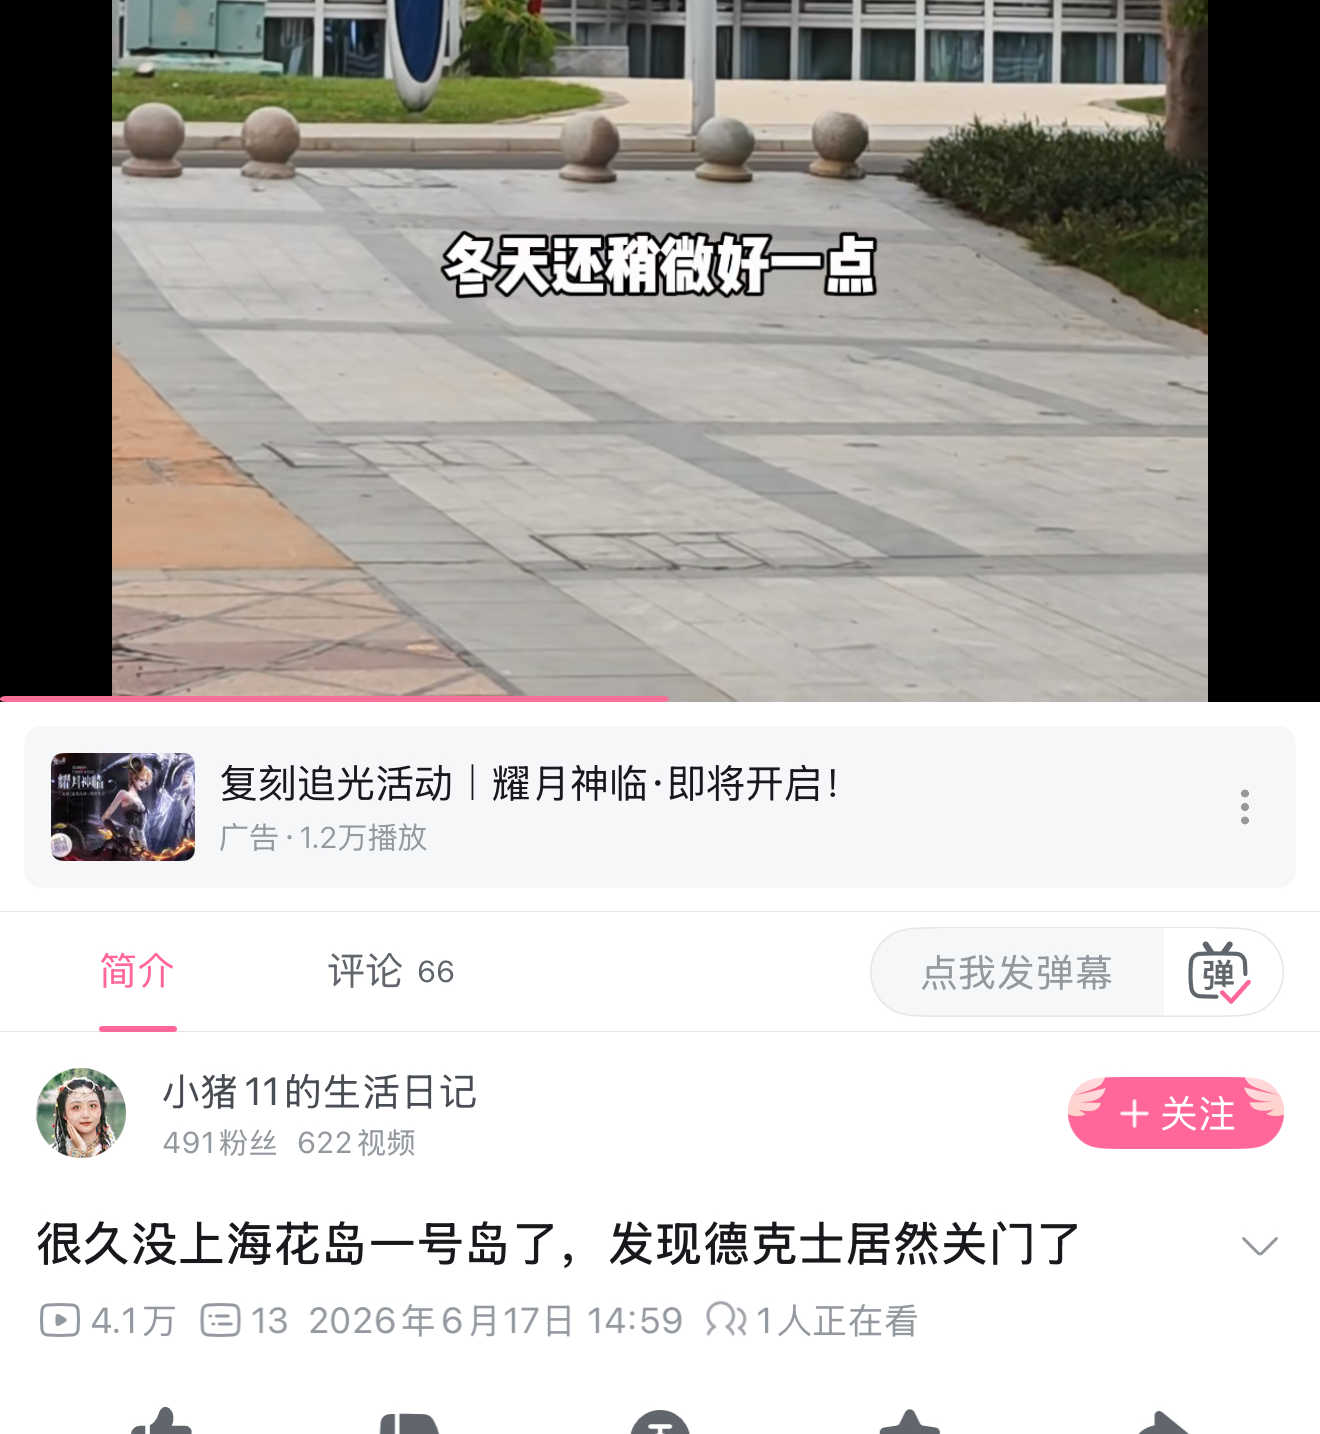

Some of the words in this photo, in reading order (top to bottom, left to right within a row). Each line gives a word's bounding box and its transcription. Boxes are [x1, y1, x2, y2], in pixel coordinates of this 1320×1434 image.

[101, 953, 174, 989] 简介
[328, 953, 402, 989] 评论
[419, 960, 453, 983] 66
[922, 955, 1111, 991] 点我发弹幕
[1203, 959, 1234, 990] 弹
[163, 1074, 476, 1109] 小猪11的生活日记
[1162, 1096, 1235, 1132] 关注
[164, 1129, 276, 1157] 491粉丝
[299, 1129, 415, 1157] 622视频
[38, 1221, 1078, 1268] 很久没上海花岛一号岛了，发现德克士居然关门了
[92, 1306, 176, 1337] 4.1万
[253, 1307, 287, 1334] 13
[311, 1304, 570, 1337] 2026年6月17日
[589, 1307, 681, 1334] 14:59
[758, 1304, 917, 1337] 1人正在看
